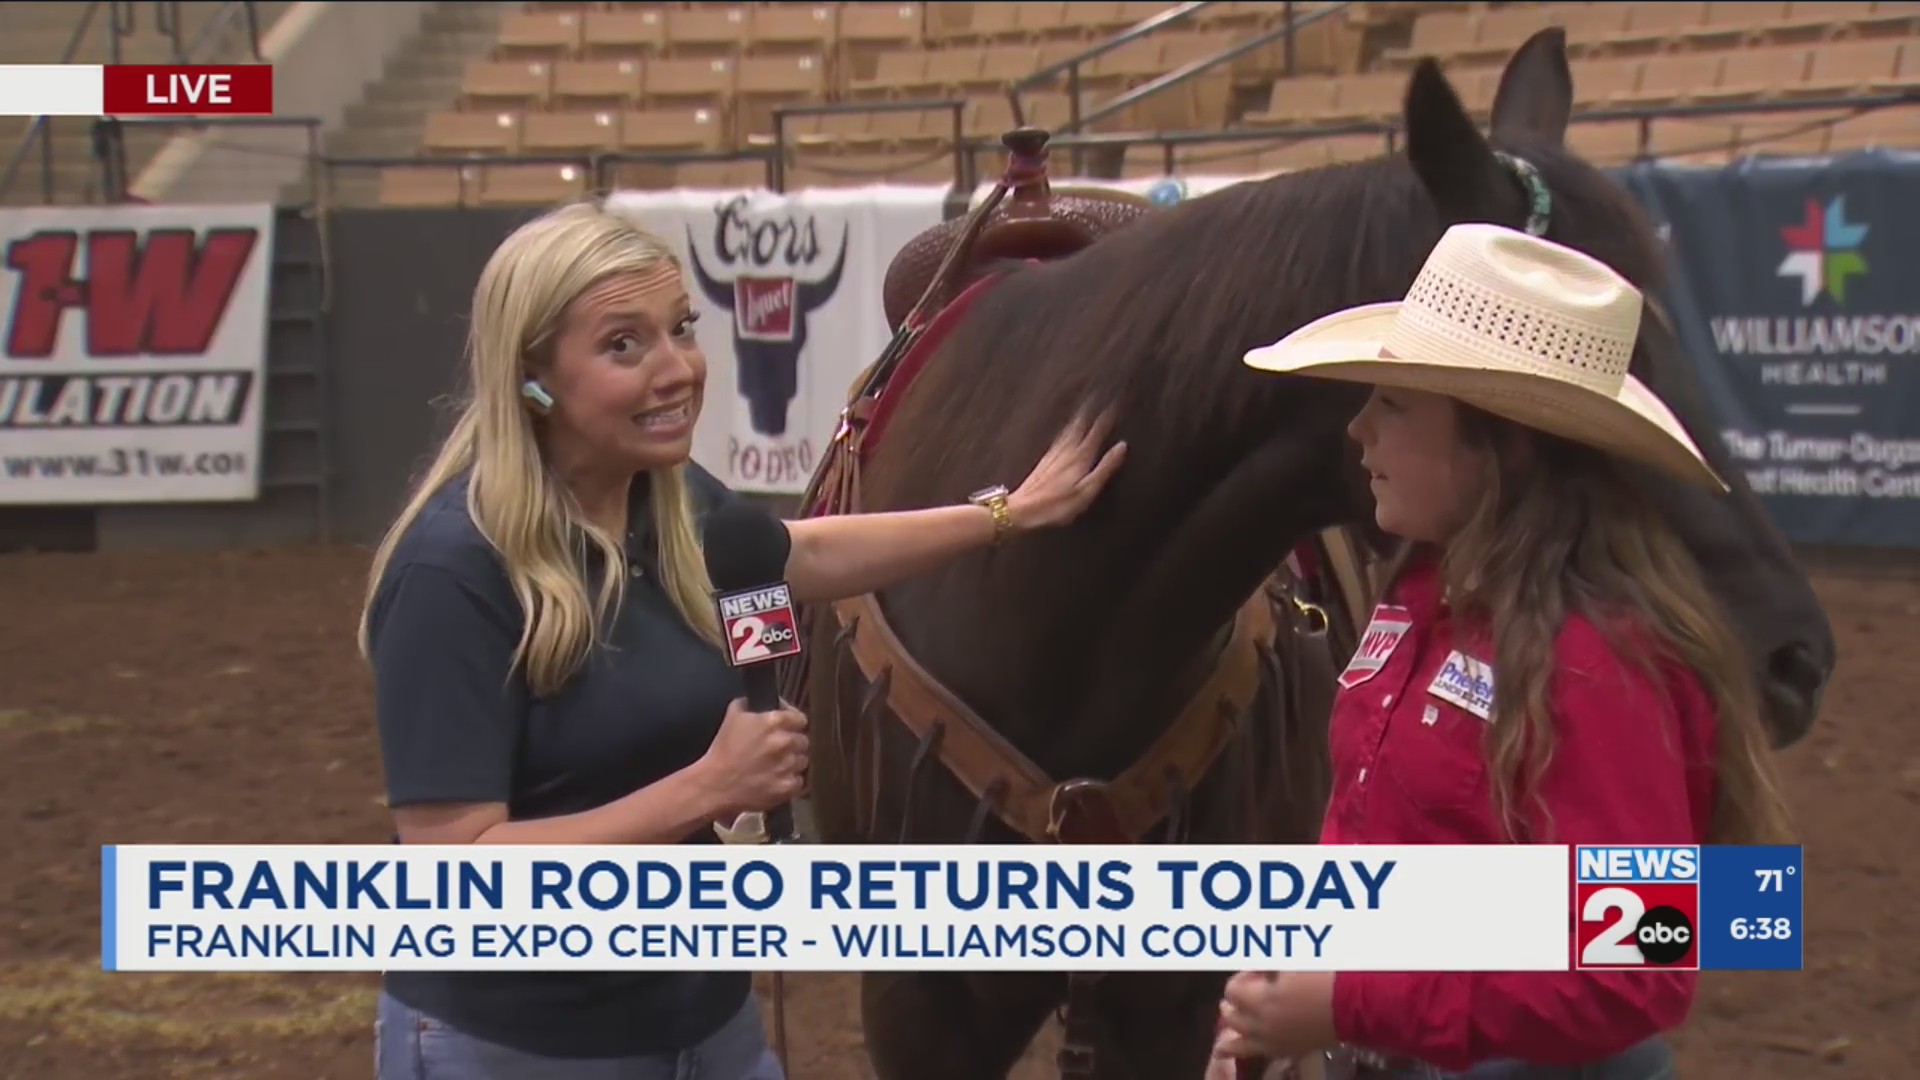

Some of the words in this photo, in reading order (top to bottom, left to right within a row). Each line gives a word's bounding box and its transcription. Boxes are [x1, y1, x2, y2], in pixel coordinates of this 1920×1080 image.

[1761, 361, 1888, 386] HEALTH
[1721, 429, 1765, 460] The
[1779, 466, 1857, 496] Health
[723, 589, 789, 617] NEWS
[732, 616, 771, 661] 2
[762, 628, 793, 645] abc
[1357, 631, 1400, 659] MVP
